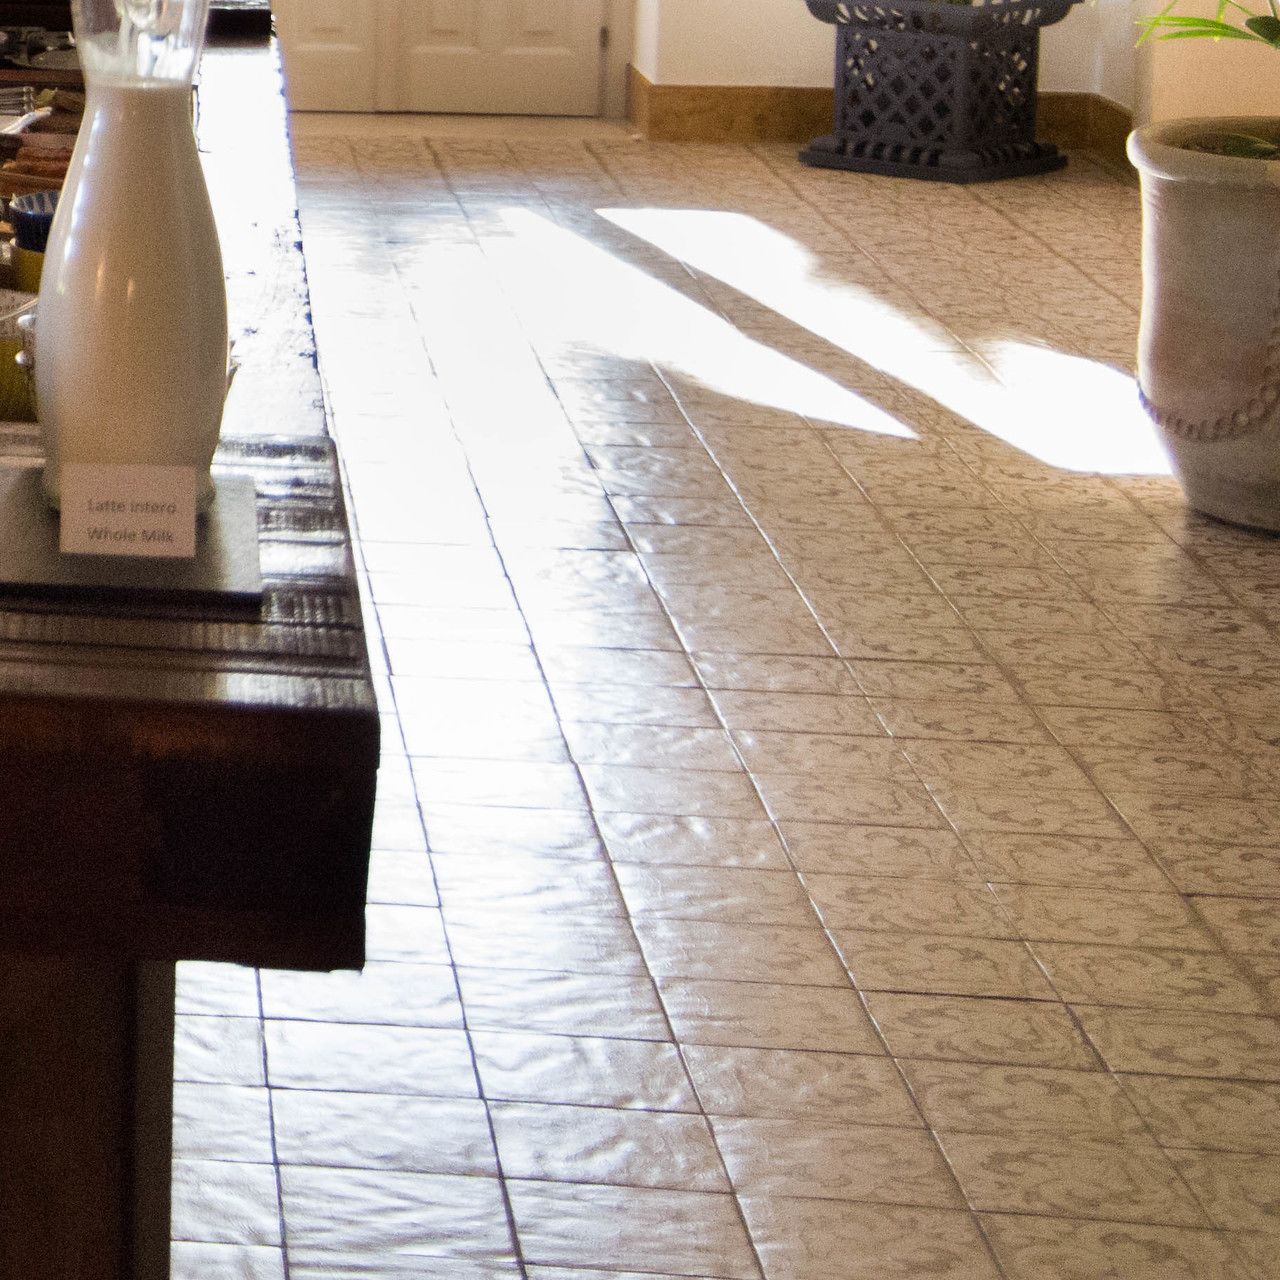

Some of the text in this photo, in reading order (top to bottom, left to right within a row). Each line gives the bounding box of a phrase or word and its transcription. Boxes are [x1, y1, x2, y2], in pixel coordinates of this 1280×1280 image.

[87, 498, 178, 515] Latte intero
[87, 527, 175, 544] Whole Milk
